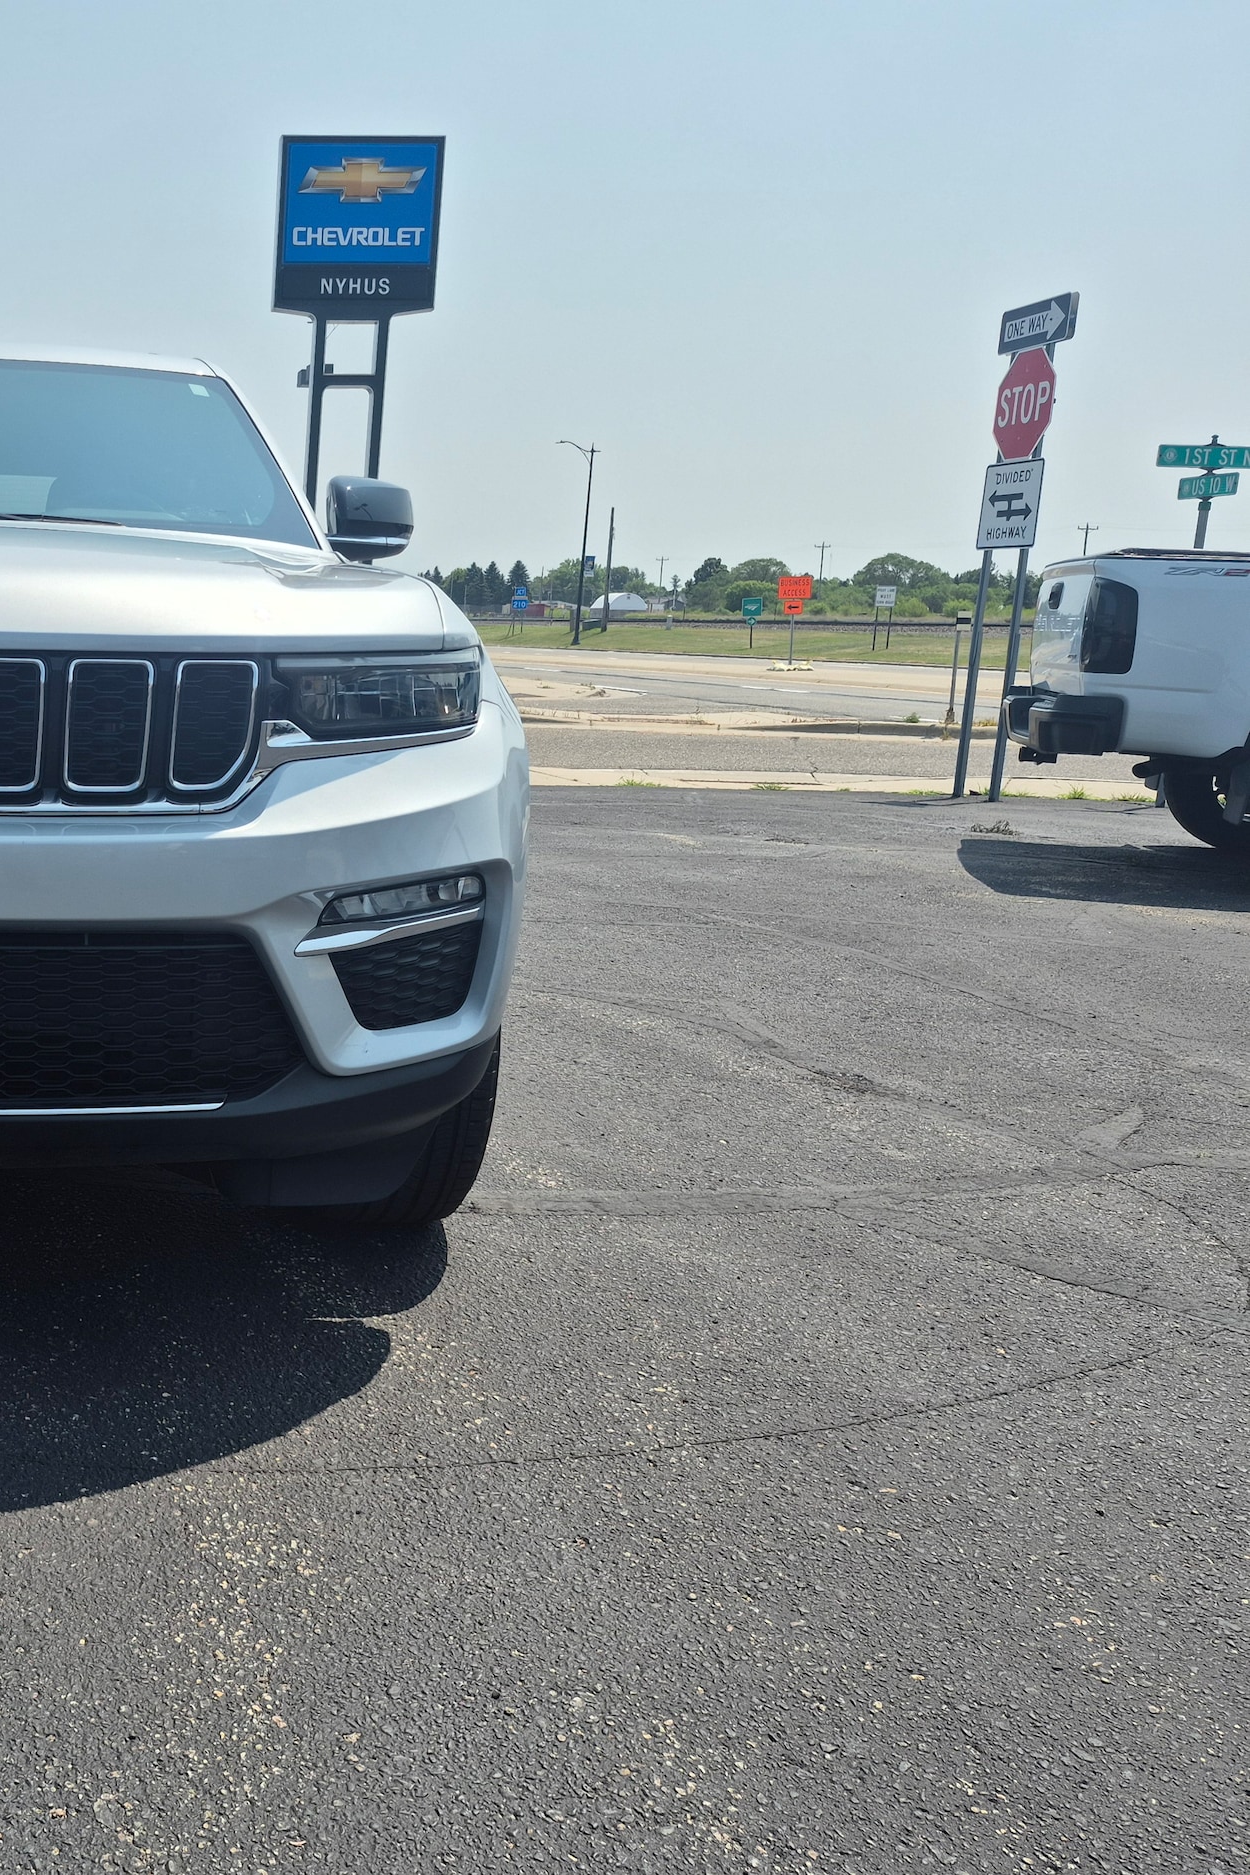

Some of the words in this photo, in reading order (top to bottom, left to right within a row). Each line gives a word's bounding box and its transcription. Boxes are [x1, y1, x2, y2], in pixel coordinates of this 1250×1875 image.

[292, 227, 425, 246] CHEVROLET
[320, 278, 391, 295] NYHUS
[1007, 320, 1026, 340] ONE
[1028, 313, 1049, 333] WAY
[997, 380, 1050, 428] STOP
[1184, 448, 1212, 465] 1ST
[1218, 449, 1238, 466] ST
[995, 469, 1032, 485] DIVIDED
[1191, 478, 1206, 496] US
[1209, 477, 1221, 494] 10
[1225, 475, 1236, 493] W
[986, 525, 1027, 541] HIGHWAY
[780, 578, 810, 587] BUSINESS
[783, 589, 806, 597] ACCESS
[513, 601, 526, 609] 210
